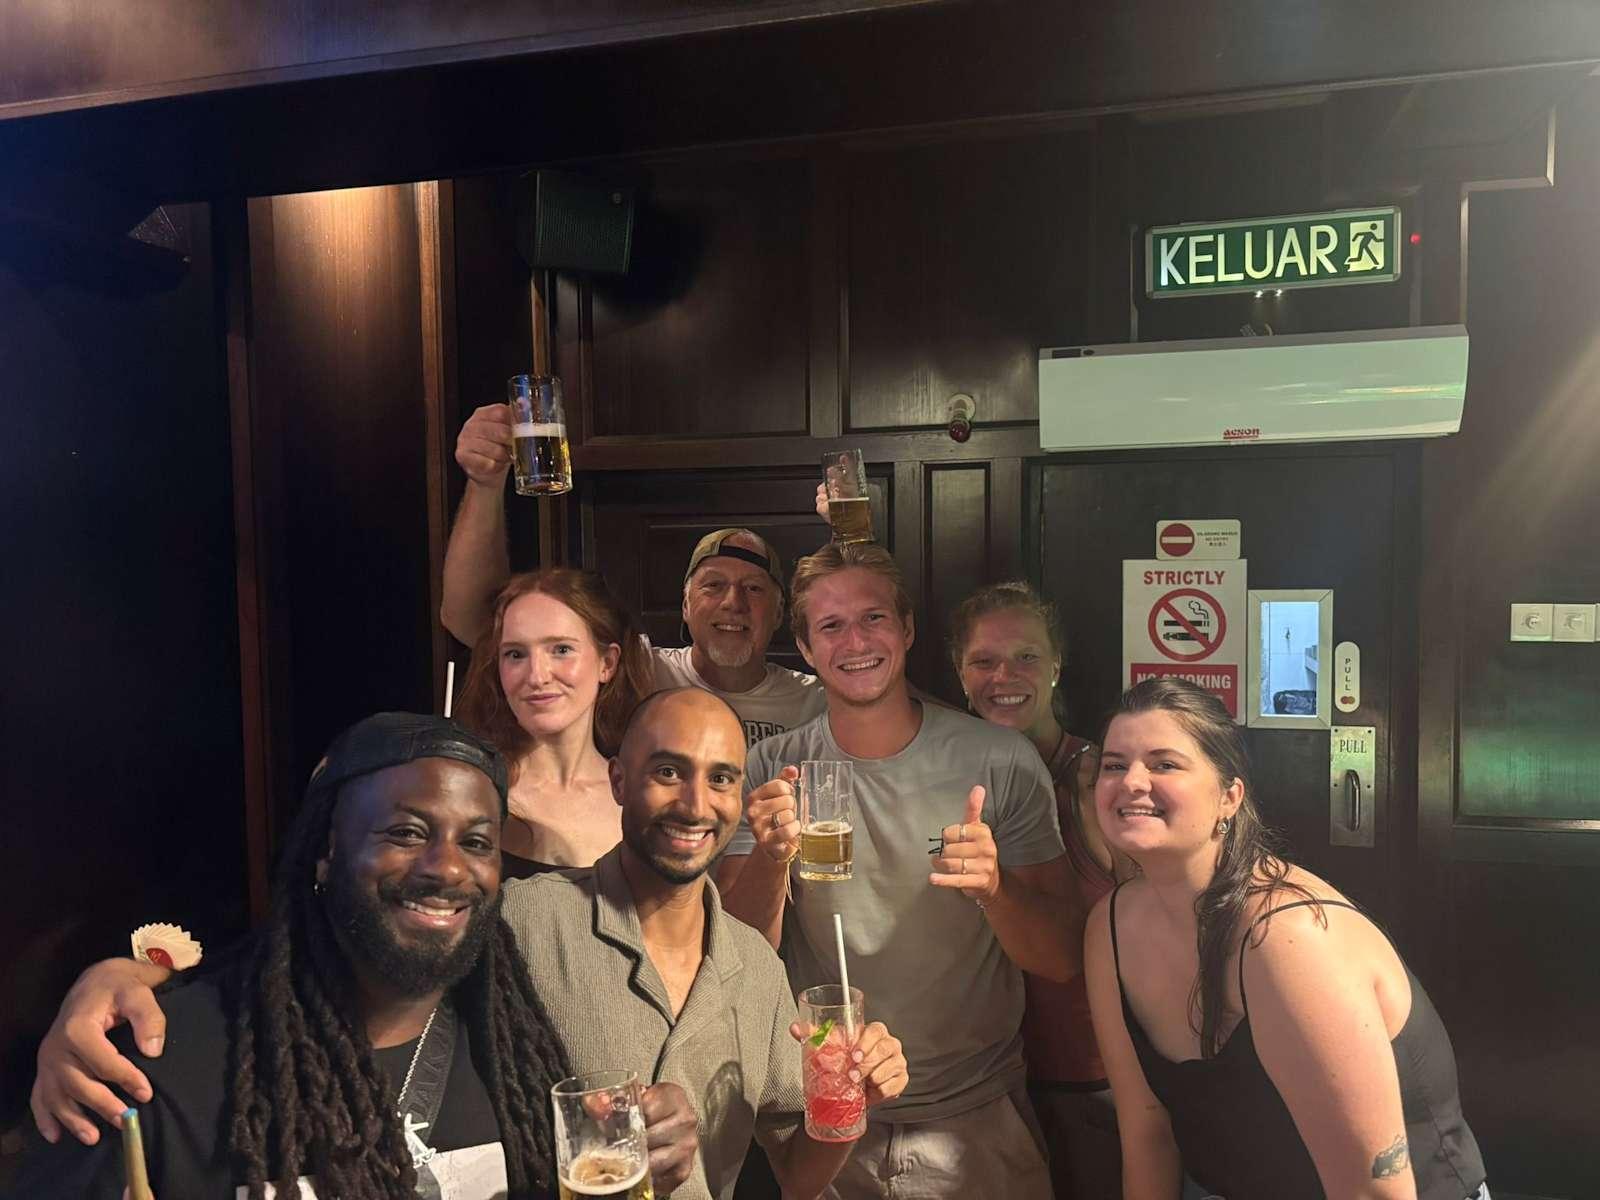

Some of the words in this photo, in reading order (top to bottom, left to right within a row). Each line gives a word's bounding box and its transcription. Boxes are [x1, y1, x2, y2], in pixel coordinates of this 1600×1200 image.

[1159, 224, 1338, 286] KELUAR
[1143, 570, 1225, 585] STRICTLY
[1340, 740, 1367, 753] PULL
